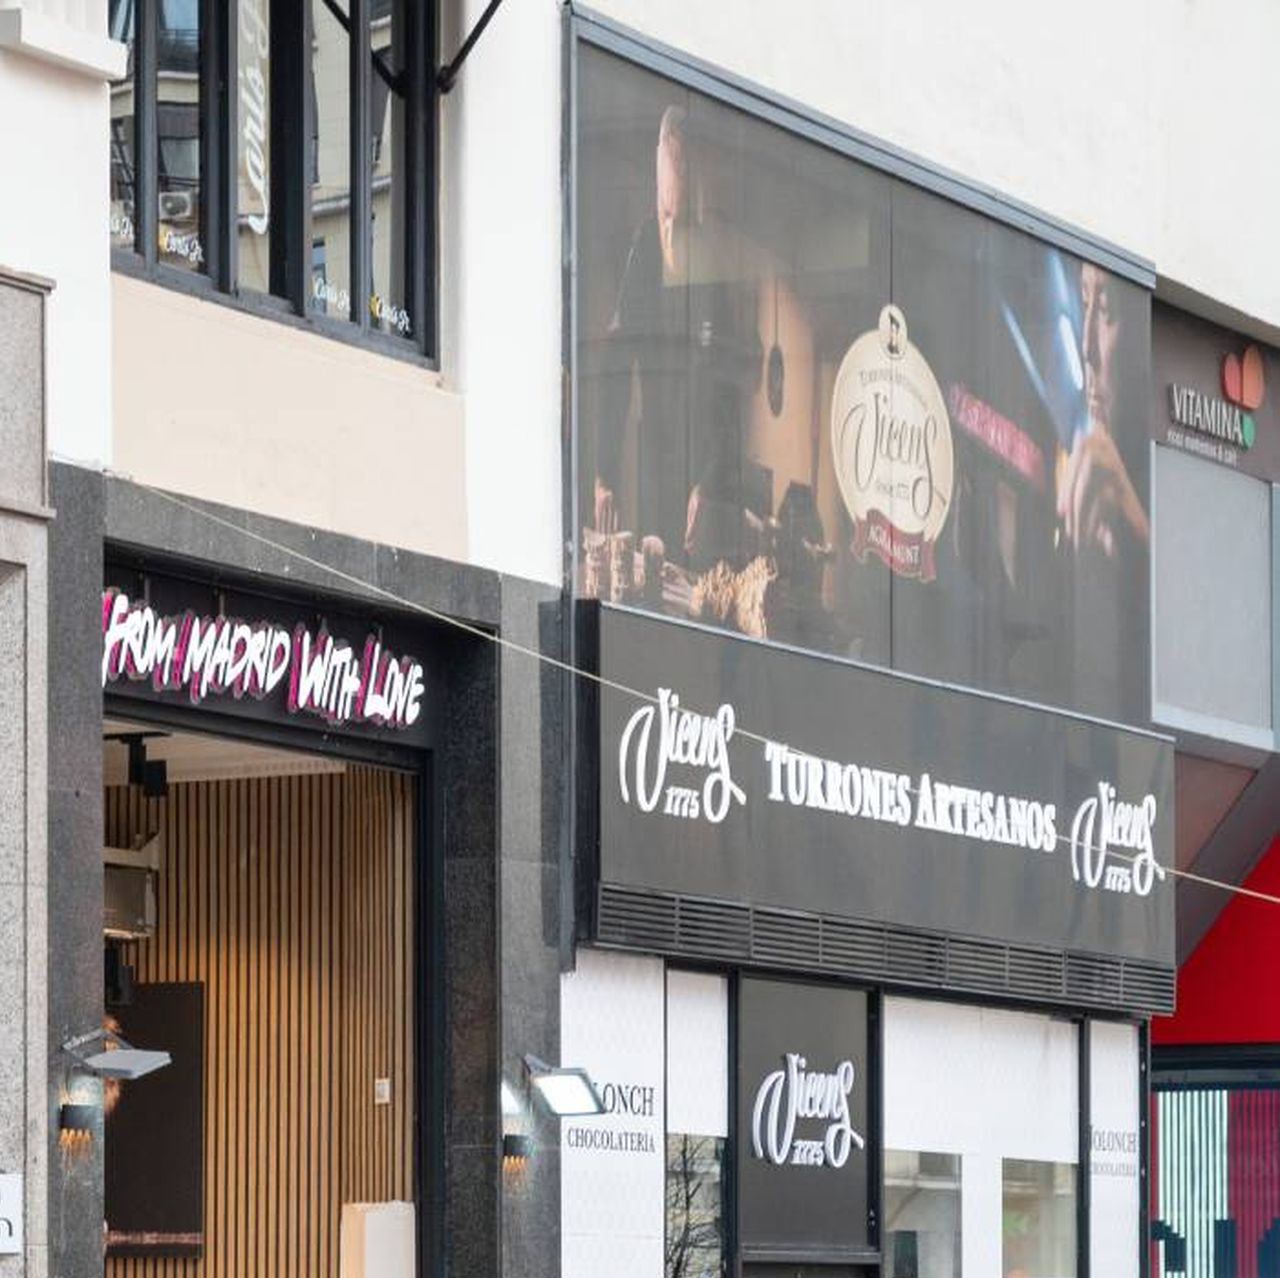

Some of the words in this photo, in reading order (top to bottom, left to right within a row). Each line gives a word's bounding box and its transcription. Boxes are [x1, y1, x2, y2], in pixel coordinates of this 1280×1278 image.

[1173, 383, 1244, 446] VITAMINA
[103, 594, 176, 688] FROM
[183, 617, 291, 698] MADRID
[298, 630, 361, 720] WITH
[364, 643, 425, 725] LOVE
[619, 687, 747, 823] Vicens
[663, 786, 700, 819] 1775
[765, 741, 911, 827] TURRONES
[914, 773, 1057, 852] ARTESANOS
[1104, 865, 1131, 893] 1775
[567, 1126, 656, 1154] CHOCOLATERIA
